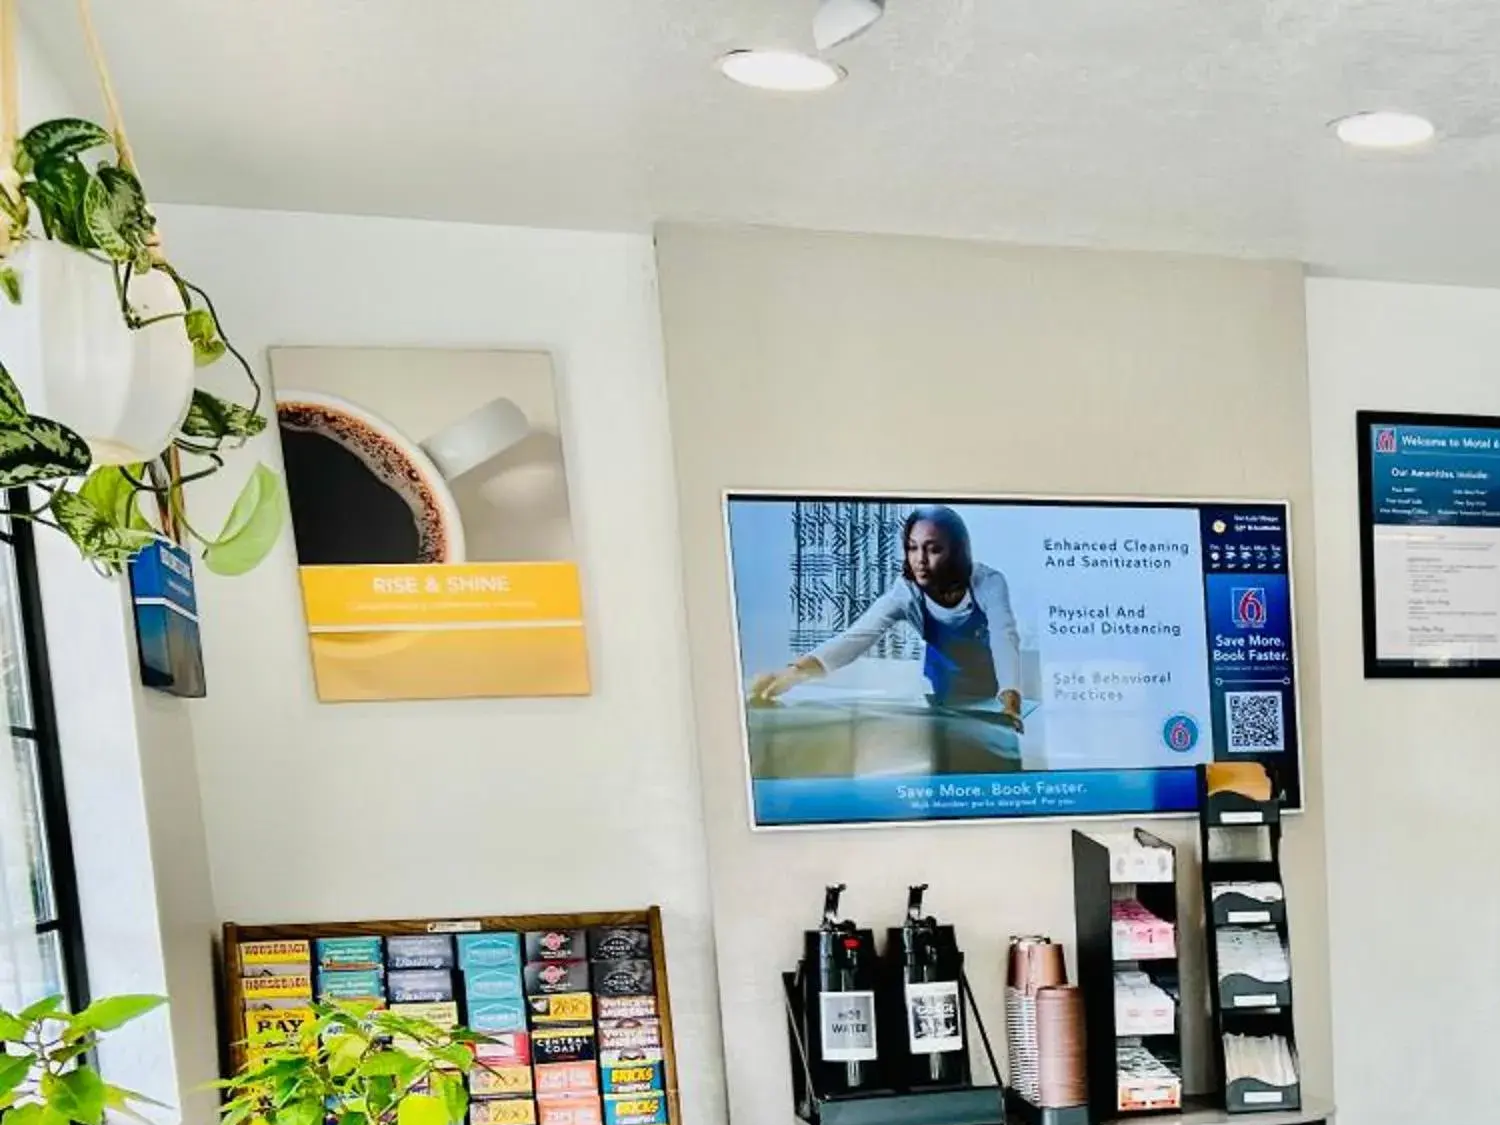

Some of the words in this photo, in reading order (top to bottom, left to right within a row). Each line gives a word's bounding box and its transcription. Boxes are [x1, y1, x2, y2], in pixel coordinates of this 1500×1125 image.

[1401, 436, 1446, 447] Welcome
[1043, 539, 1117, 551] Enhanced
[1123, 539, 1189, 555] Cleaning
[1045, 556, 1075, 567] And
[1081, 556, 1171, 568] Sanitization
[373, 577, 418, 594] RISE
[425, 576, 438, 593] &
[447, 575, 511, 593] SHINE
[1049, 605, 1109, 620] Physical
[1116, 605, 1145, 619] And
[1049, 622, 1095, 635] Social
[1101, 621, 1181, 637] Distancing
[1215, 634, 1245, 647] Save
[1213, 648, 1245, 661] Book
[1249, 649, 1289, 661] Faster.
[1053, 672, 1086, 685] Safe
[1092, 671, 1171, 685] Behavioral
[1055, 687, 1123, 701] Practices
[896, 784, 933, 799] Save
[939, 783, 985, 798] More.
[991, 782, 1031, 796] Book
[1036, 780, 1088, 795] Faster.
[832, 1024, 868, 1034] WATER
[537, 1038, 589, 1047] CENTRAL
[545, 1044, 581, 1054] COAST
